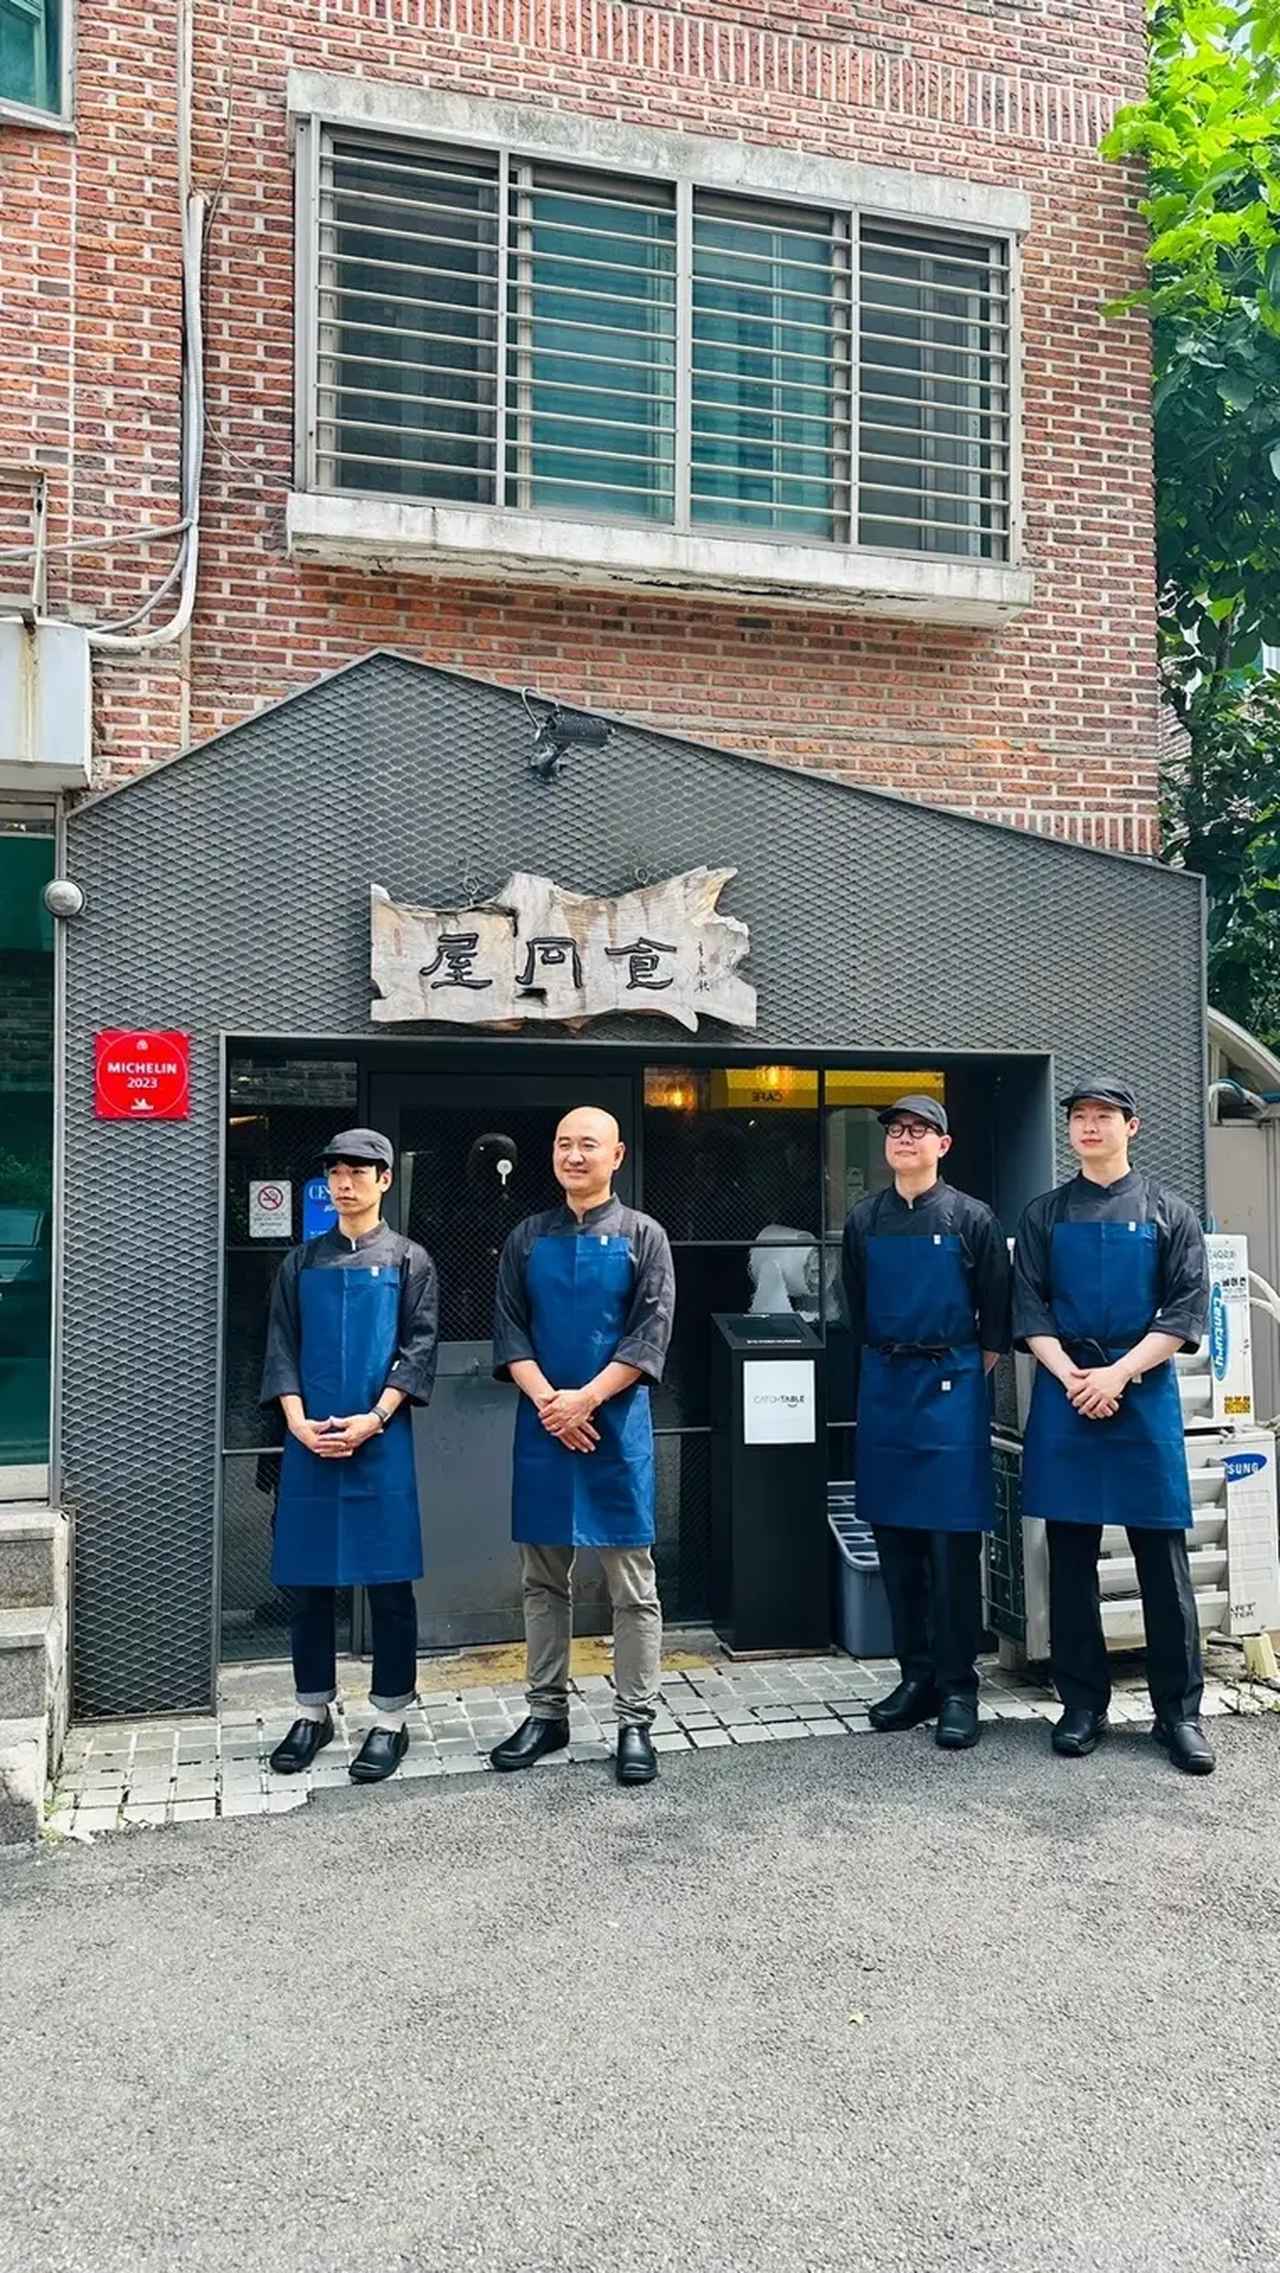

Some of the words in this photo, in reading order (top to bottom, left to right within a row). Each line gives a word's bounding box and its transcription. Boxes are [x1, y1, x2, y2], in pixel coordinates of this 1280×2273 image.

[107, 1061, 177, 1074] MICHELIN
[127, 1077, 158, 1089] 2023
[1213, 1296, 1224, 1368] Century
